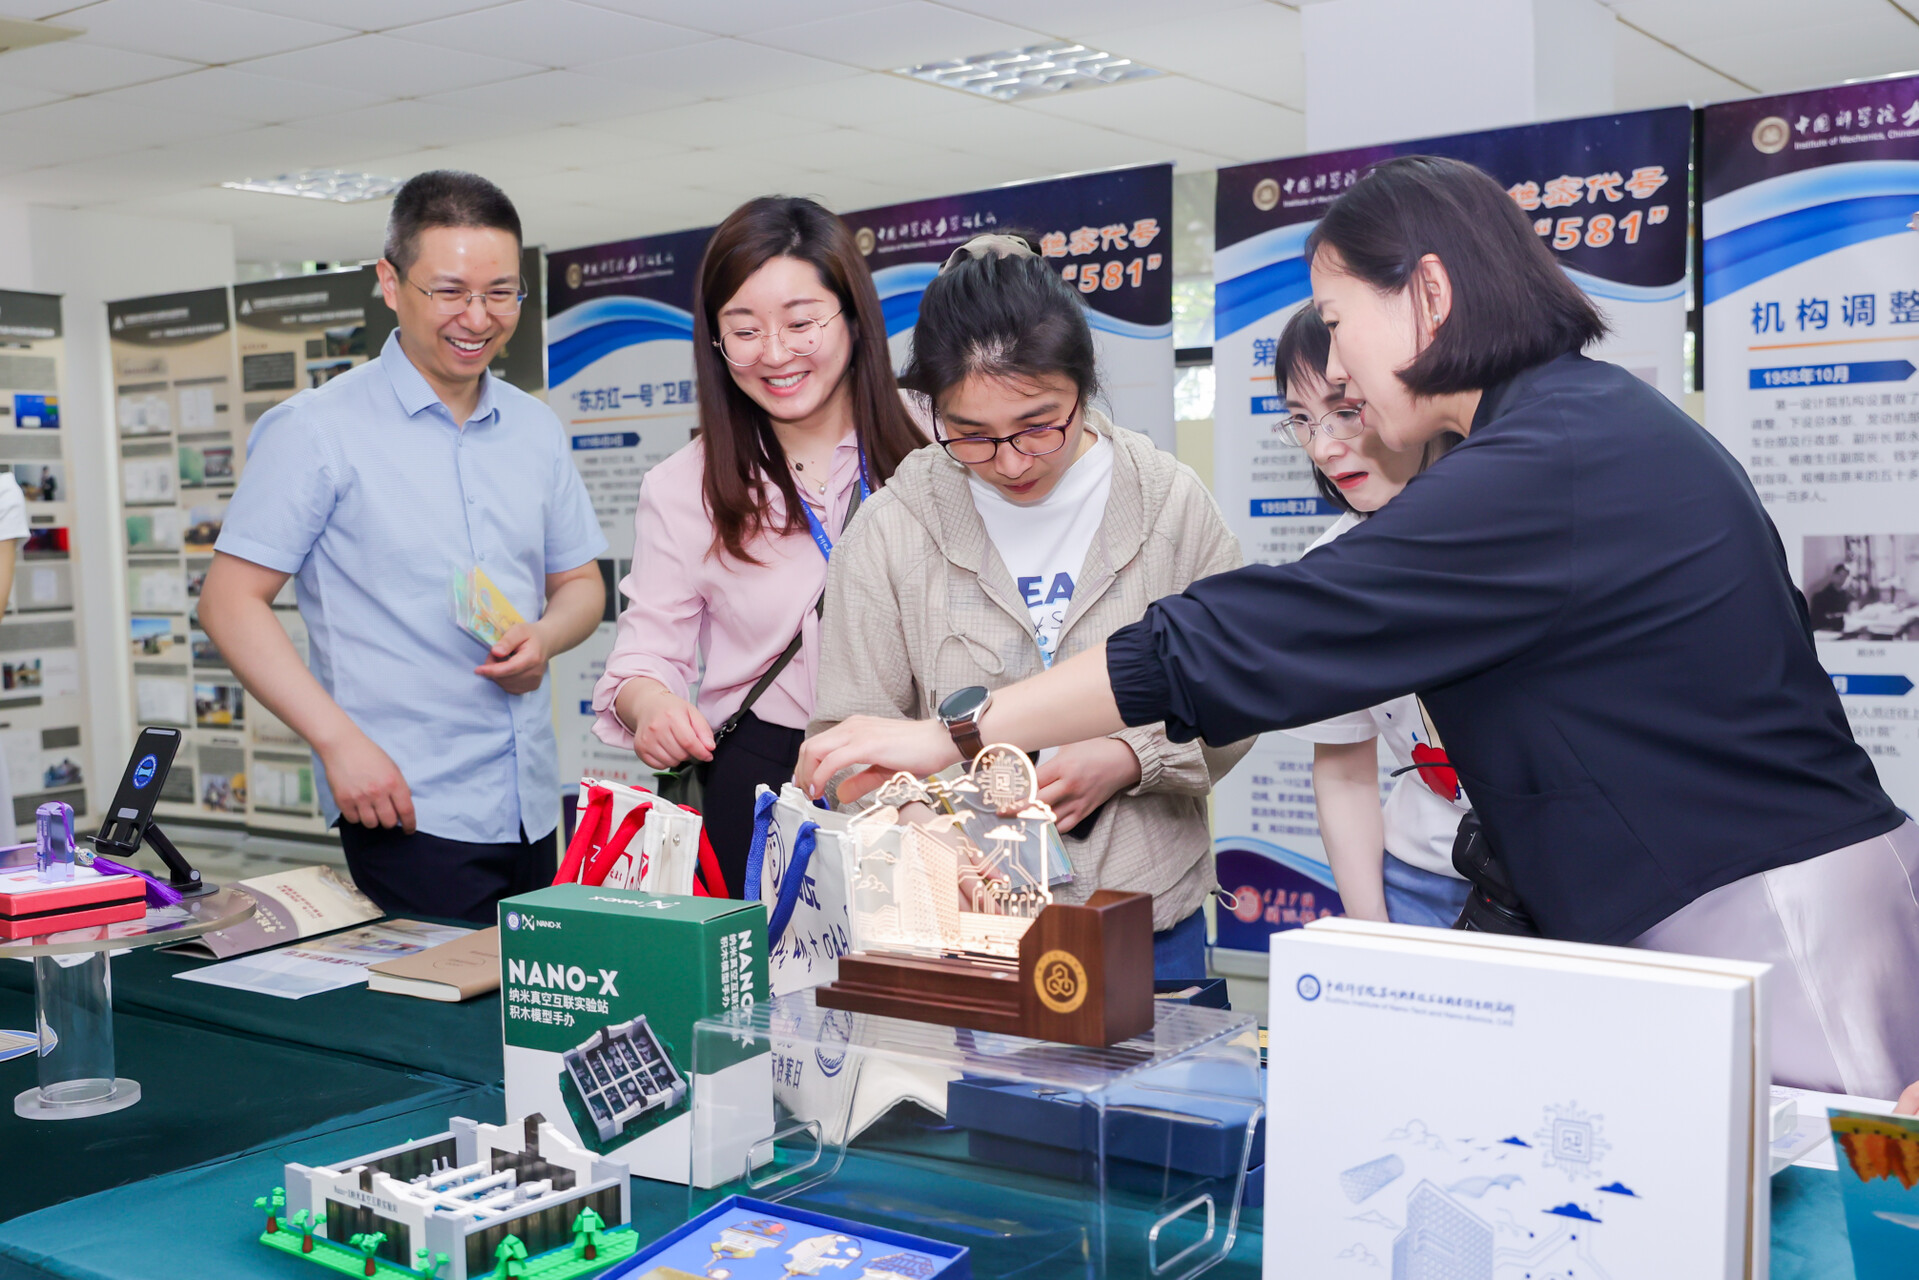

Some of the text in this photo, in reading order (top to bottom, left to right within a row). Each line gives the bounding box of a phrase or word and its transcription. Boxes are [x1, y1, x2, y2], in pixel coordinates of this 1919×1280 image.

[1283, 168, 1376, 194] 中国科学院
[1752, 290, 1919, 334] 机构调整
[1763, 365, 1849, 386] 1958年10月
[536, 920, 561, 929] NANO-X
[508, 958, 620, 997] NANO-X
[508, 988, 609, 1014] 纳米真空互联实验站
[509, 1005, 576, 1027] 积木模型手办
